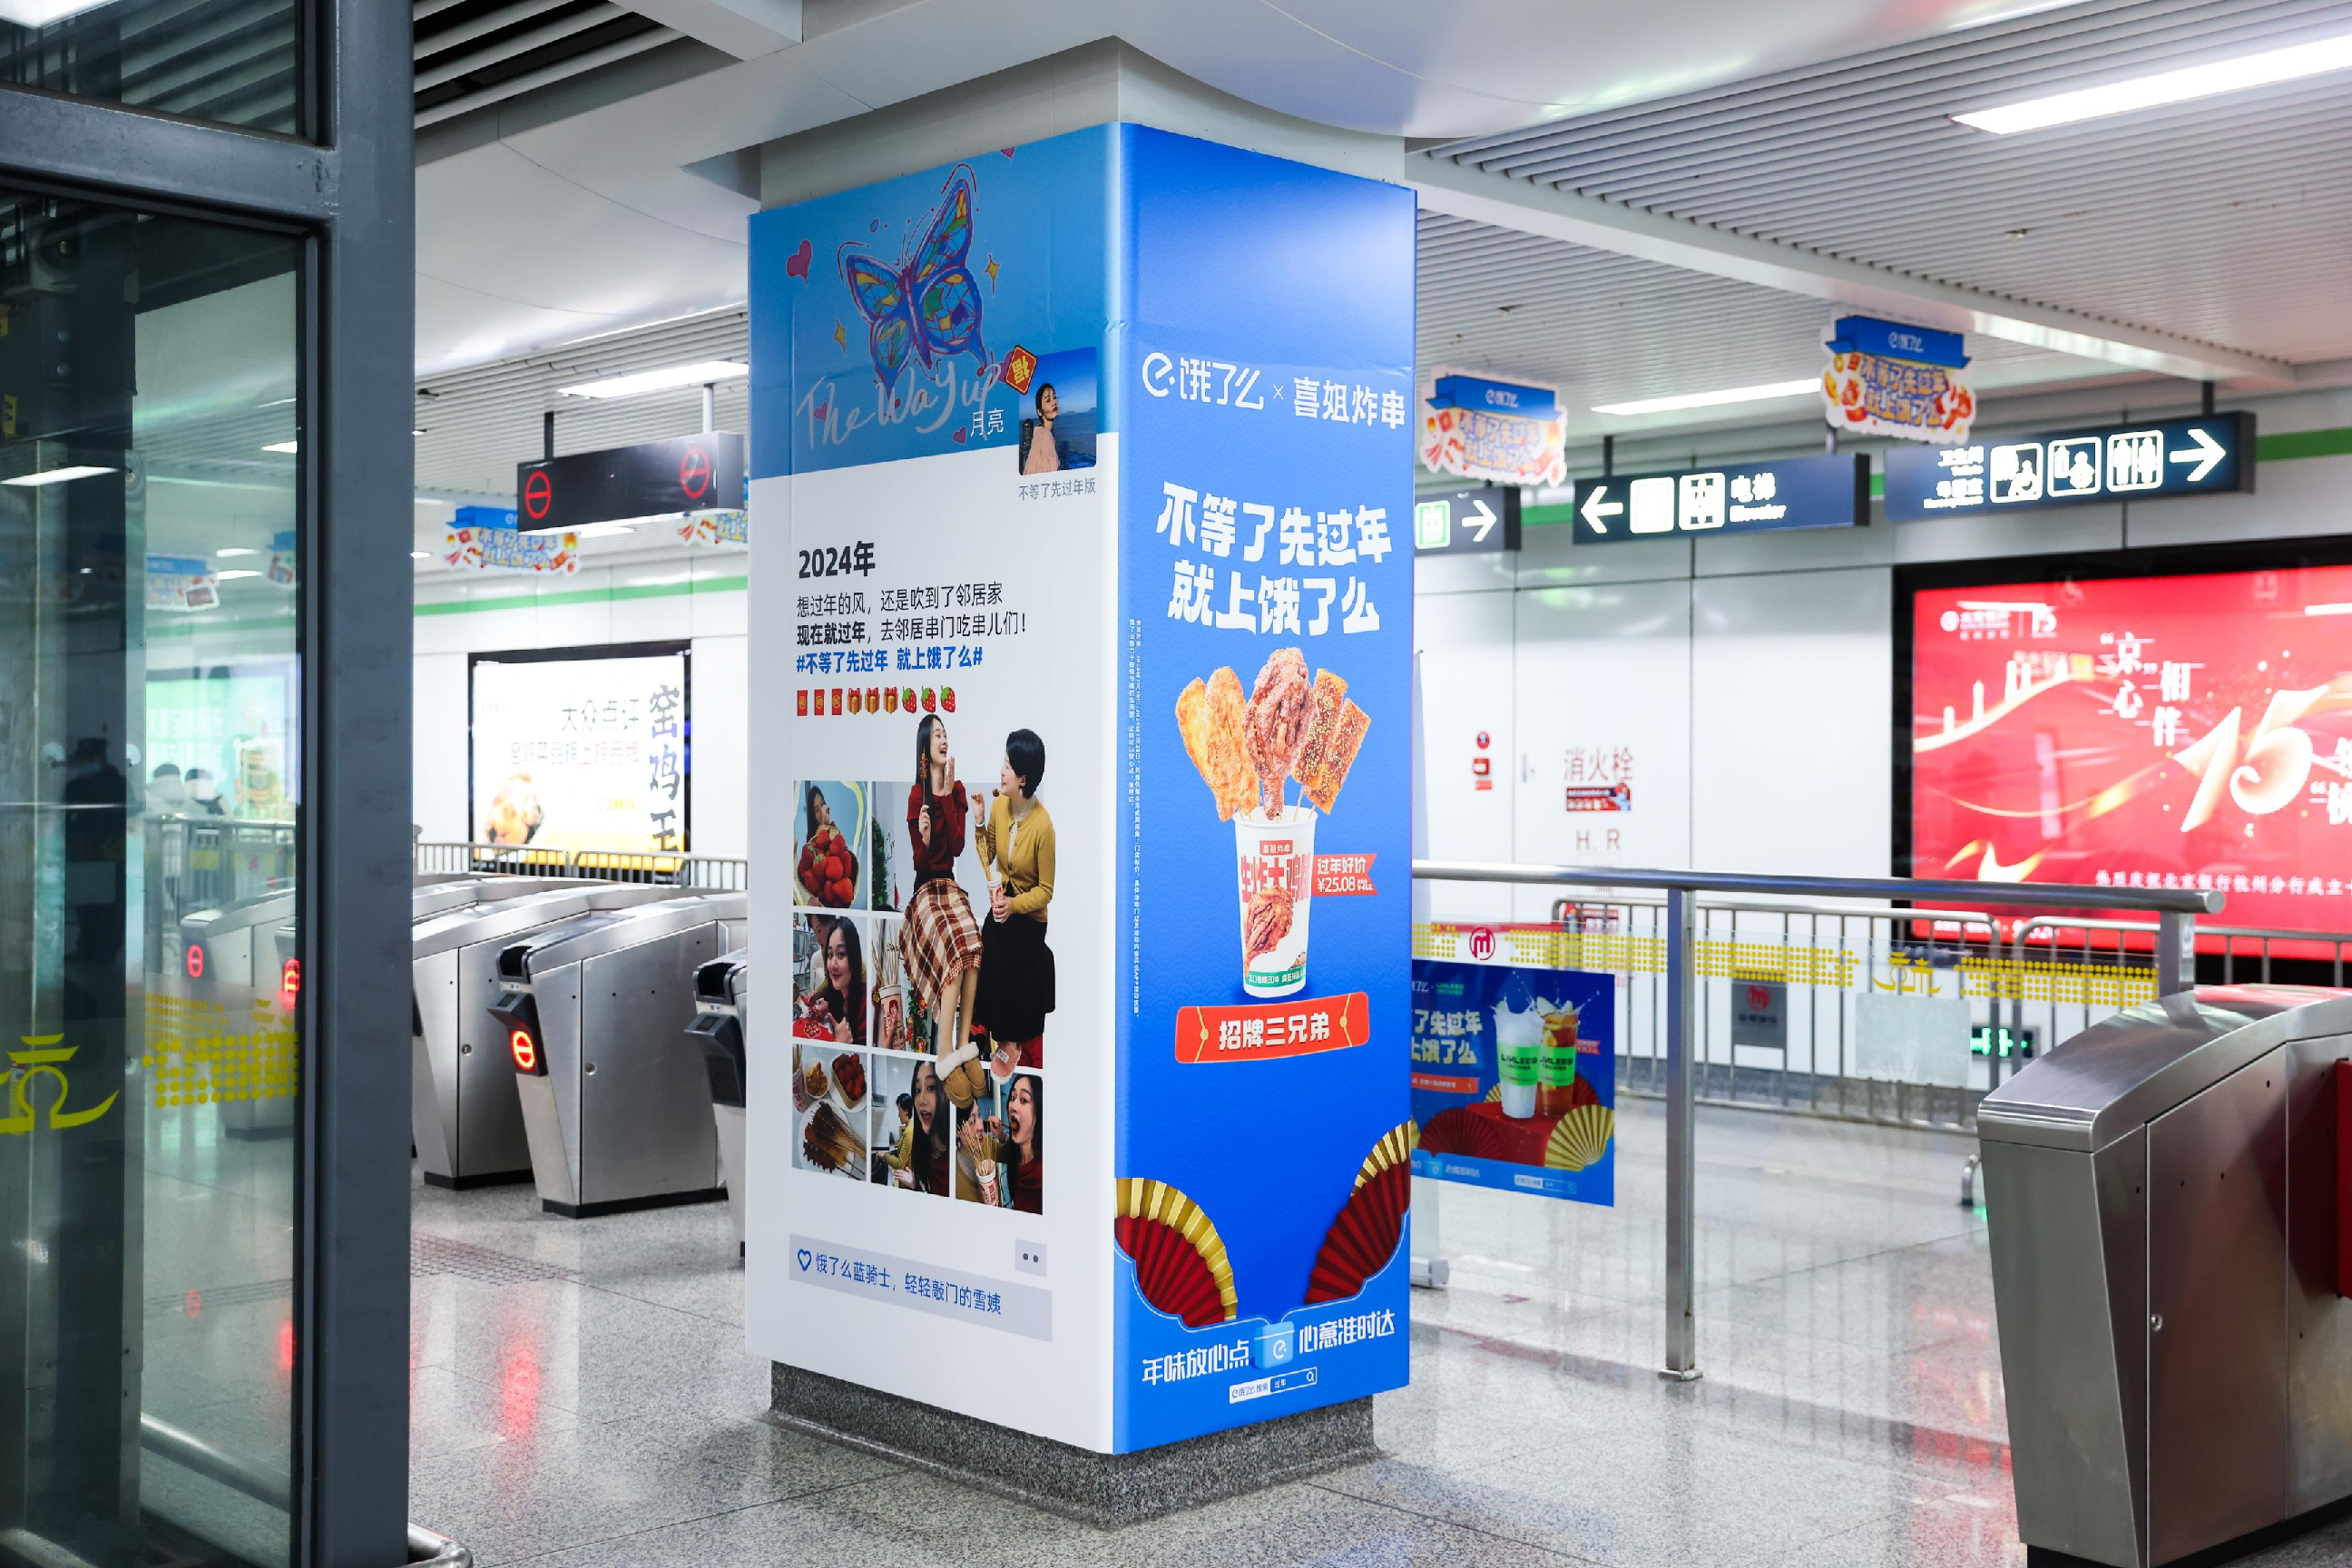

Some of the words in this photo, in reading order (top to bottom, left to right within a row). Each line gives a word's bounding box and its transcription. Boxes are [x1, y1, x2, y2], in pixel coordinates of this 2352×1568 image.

[796, 376, 876, 448] The
[1180, 357, 1264, 410] 饿了么
[1293, 376, 1406, 430] 喜姐炸串
[970, 408, 1004, 437] 月亮
[1018, 477, 1096, 501] 不等了先过年版
[1155, 480, 1393, 566] 不等了先过年
[799, 541, 876, 579] 2024年
[797, 581, 1003, 618] 想过年的风，还是吹到了邻居家
[1168, 559, 1380, 636] 就上饿了么
[797, 649, 888, 675] #不等了先过年
[897, 645, 983, 671] 就上饿了么#
[1563, 746, 1634, 781] 消火栓
[1317, 876, 1356, 893] ¥25.08
[1318, 857, 1367, 875] 过年好价
[1219, 1011, 1330, 1052] 招牌三兄弟
[816, 1252, 1002, 1315] 饿了么蓝骑士，轻轻敲门的雪姨
[1142, 1339, 1250, 1386] 年味放心点
[1298, 1308, 1396, 1355] 心意准时达
[1274, 1379, 1287, 1389] 过年
